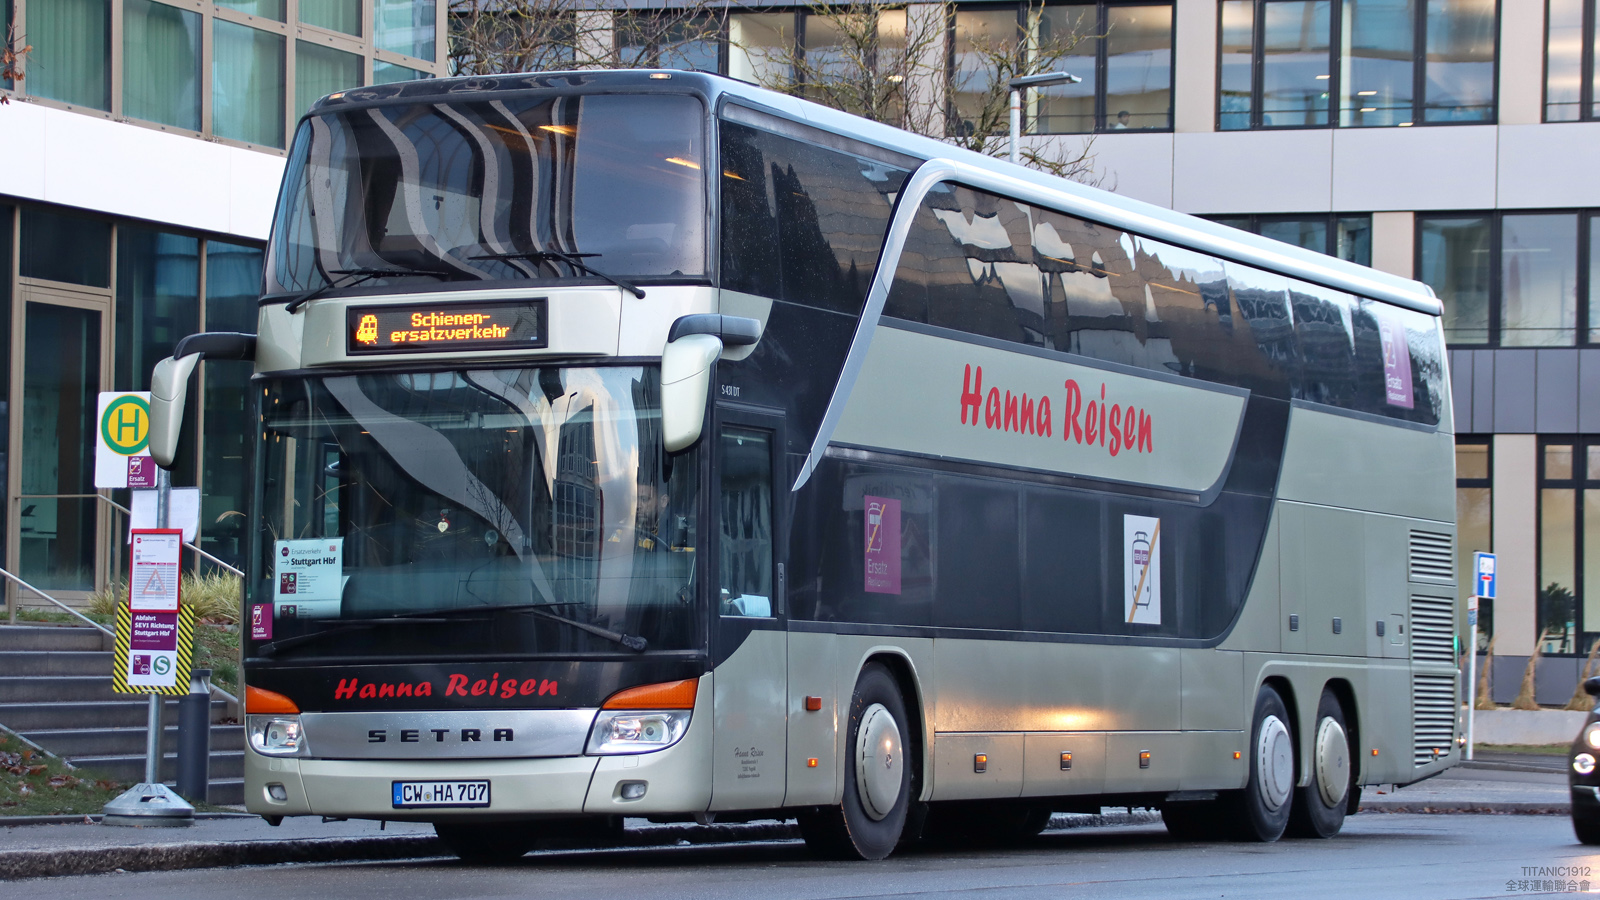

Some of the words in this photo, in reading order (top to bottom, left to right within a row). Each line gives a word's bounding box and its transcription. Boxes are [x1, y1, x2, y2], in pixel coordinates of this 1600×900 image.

[411, 312, 490, 328] Schienen-
[390, 324, 510, 342] ersatzverkehr
[1386, 373, 1402, 390] Ersatz
[960, 363, 1052, 438] Hanna
[1064, 378, 1152, 456] Reisen
[117, 409, 140, 441] H
[291, 557, 321, 567] Stuttgart
[868, 558, 888, 574] Ersatz
[334, 678, 432, 700] Hanna
[445, 672, 558, 698] Reisen
[368, 728, 514, 742] SETRA
[403, 785, 423, 802] CW
[434, 784, 453, 801] HA
[458, 784, 486, 800] 707
